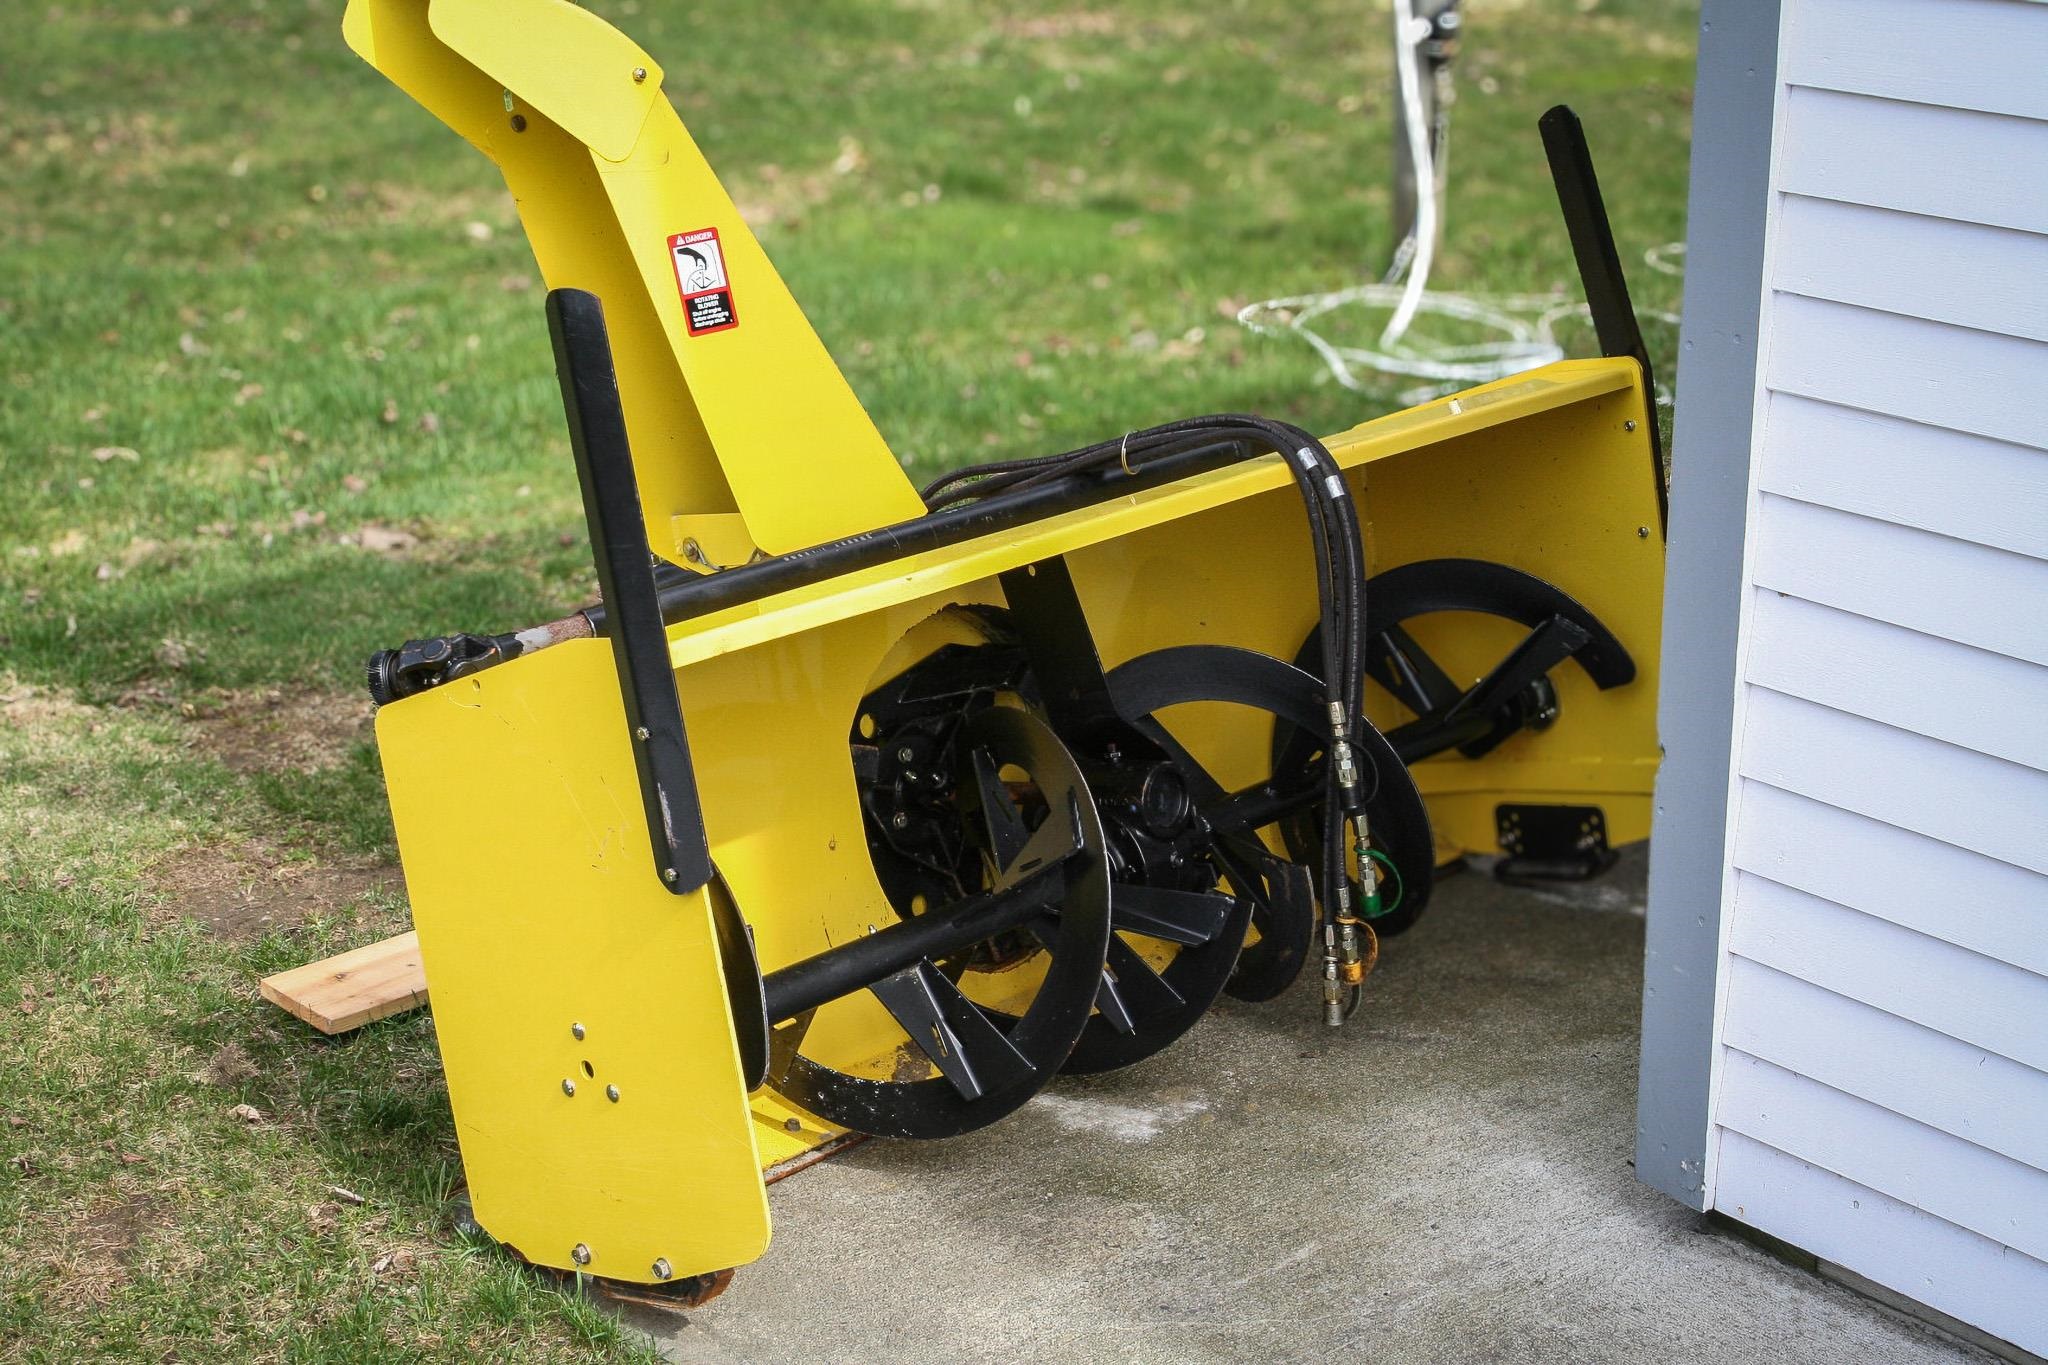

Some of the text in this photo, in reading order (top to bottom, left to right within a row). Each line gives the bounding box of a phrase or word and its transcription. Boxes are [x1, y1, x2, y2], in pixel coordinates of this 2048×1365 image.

[685, 231, 713, 244] DANGER
[694, 294, 720, 304] ROTATING
[697, 300, 719, 310] BLOWER
